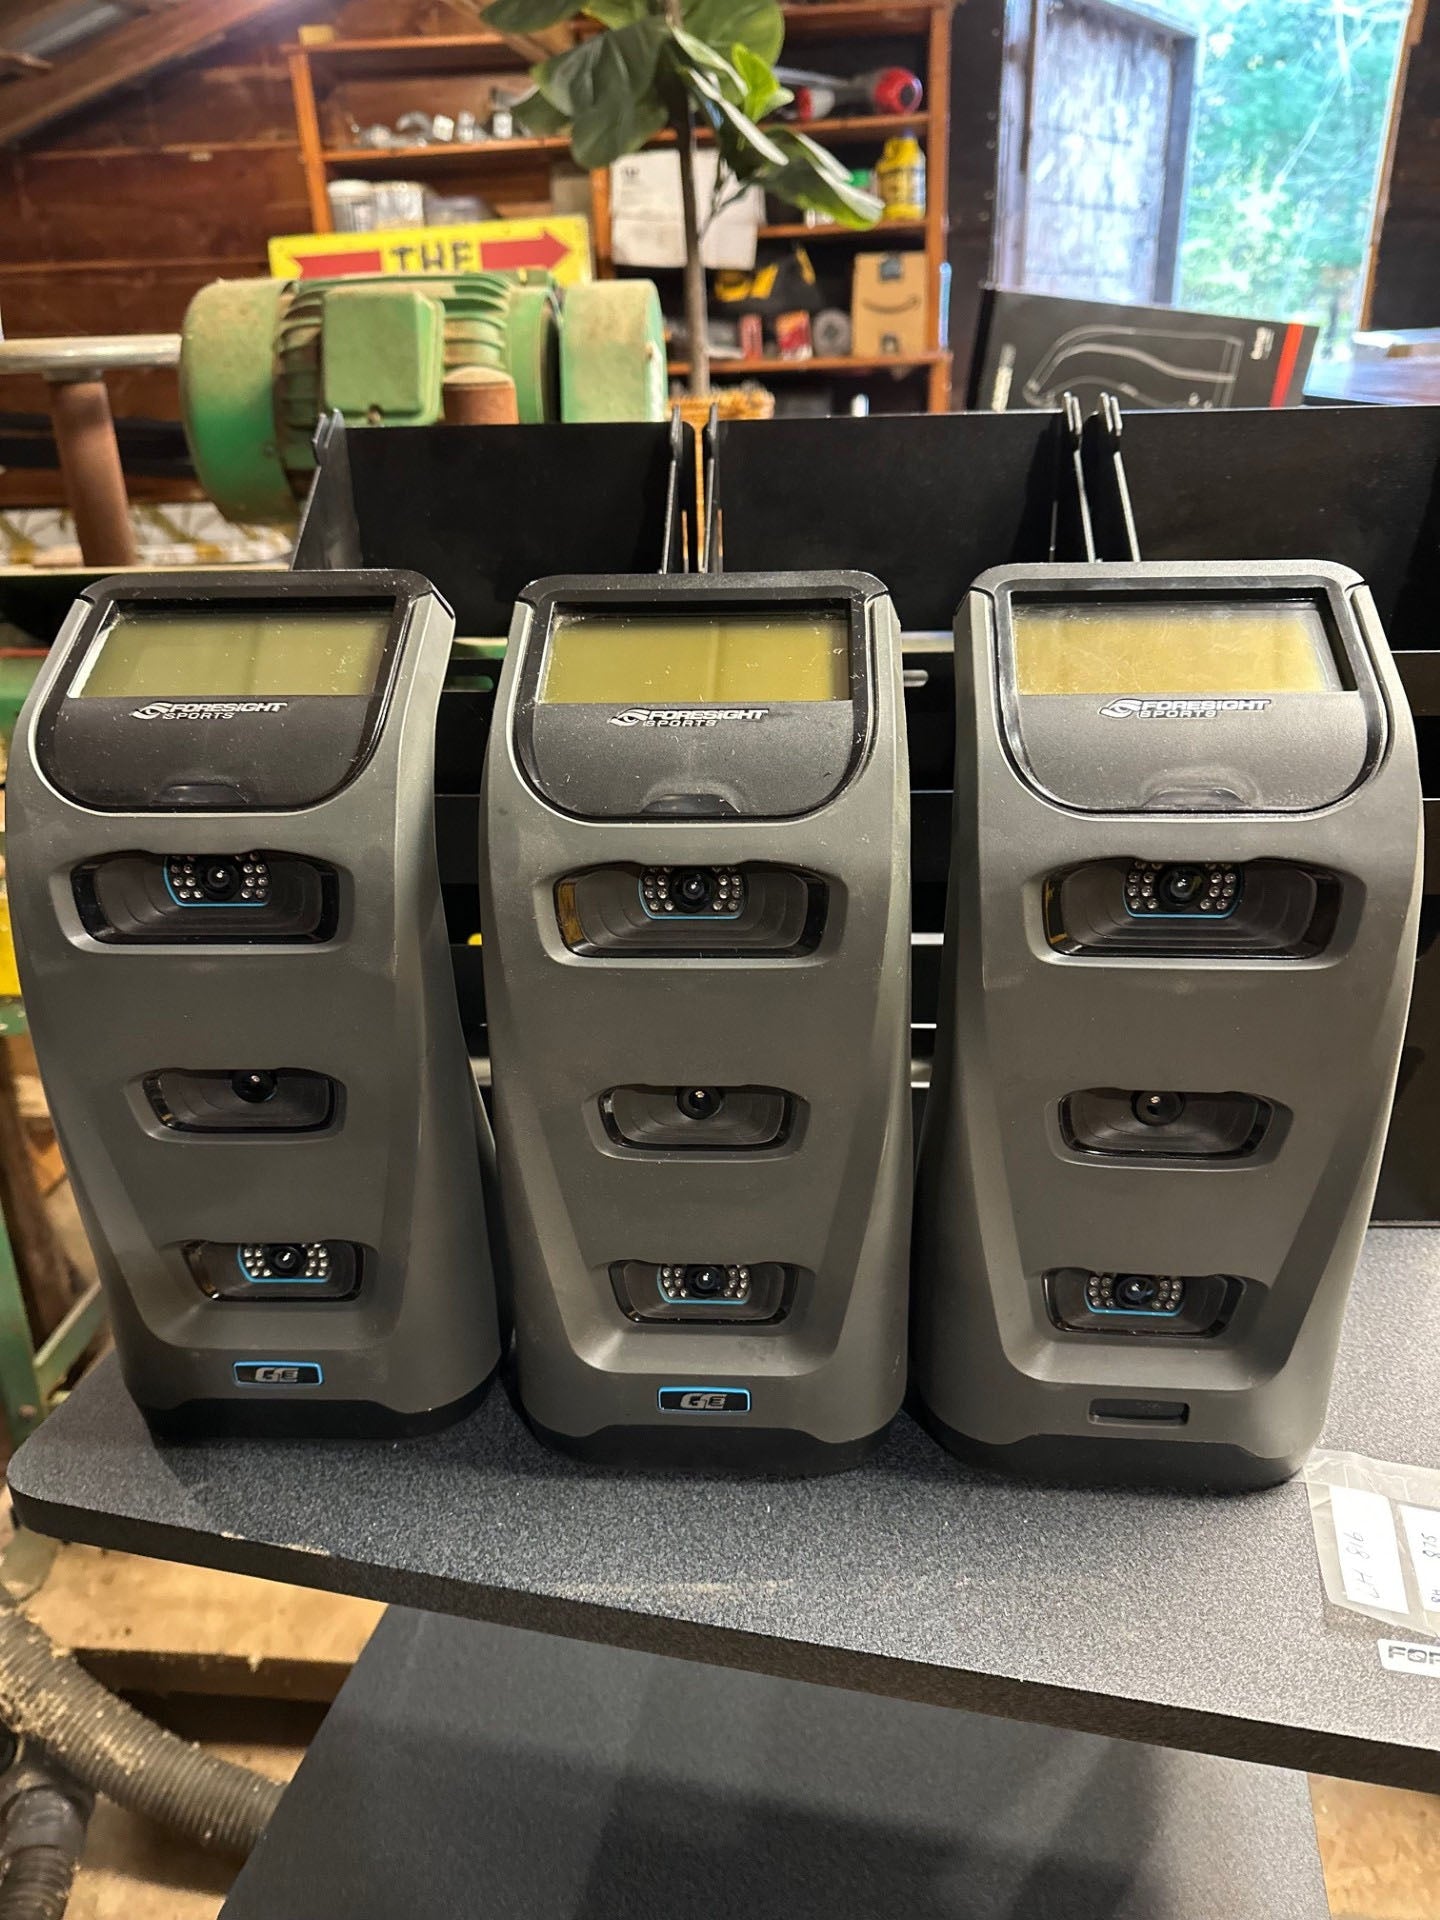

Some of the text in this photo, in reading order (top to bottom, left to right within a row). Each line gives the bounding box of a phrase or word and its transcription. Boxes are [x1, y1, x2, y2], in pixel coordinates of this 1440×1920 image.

[168, 702, 288, 712] FORESIGHT
[1141, 700, 1270, 711] FORESIGHT
[162, 712, 235, 720] SPORTS
[648, 709, 769, 720] FORESIGHT
[1139, 710, 1217, 718] SPORTS
[642, 719, 718, 727] SPORTS
